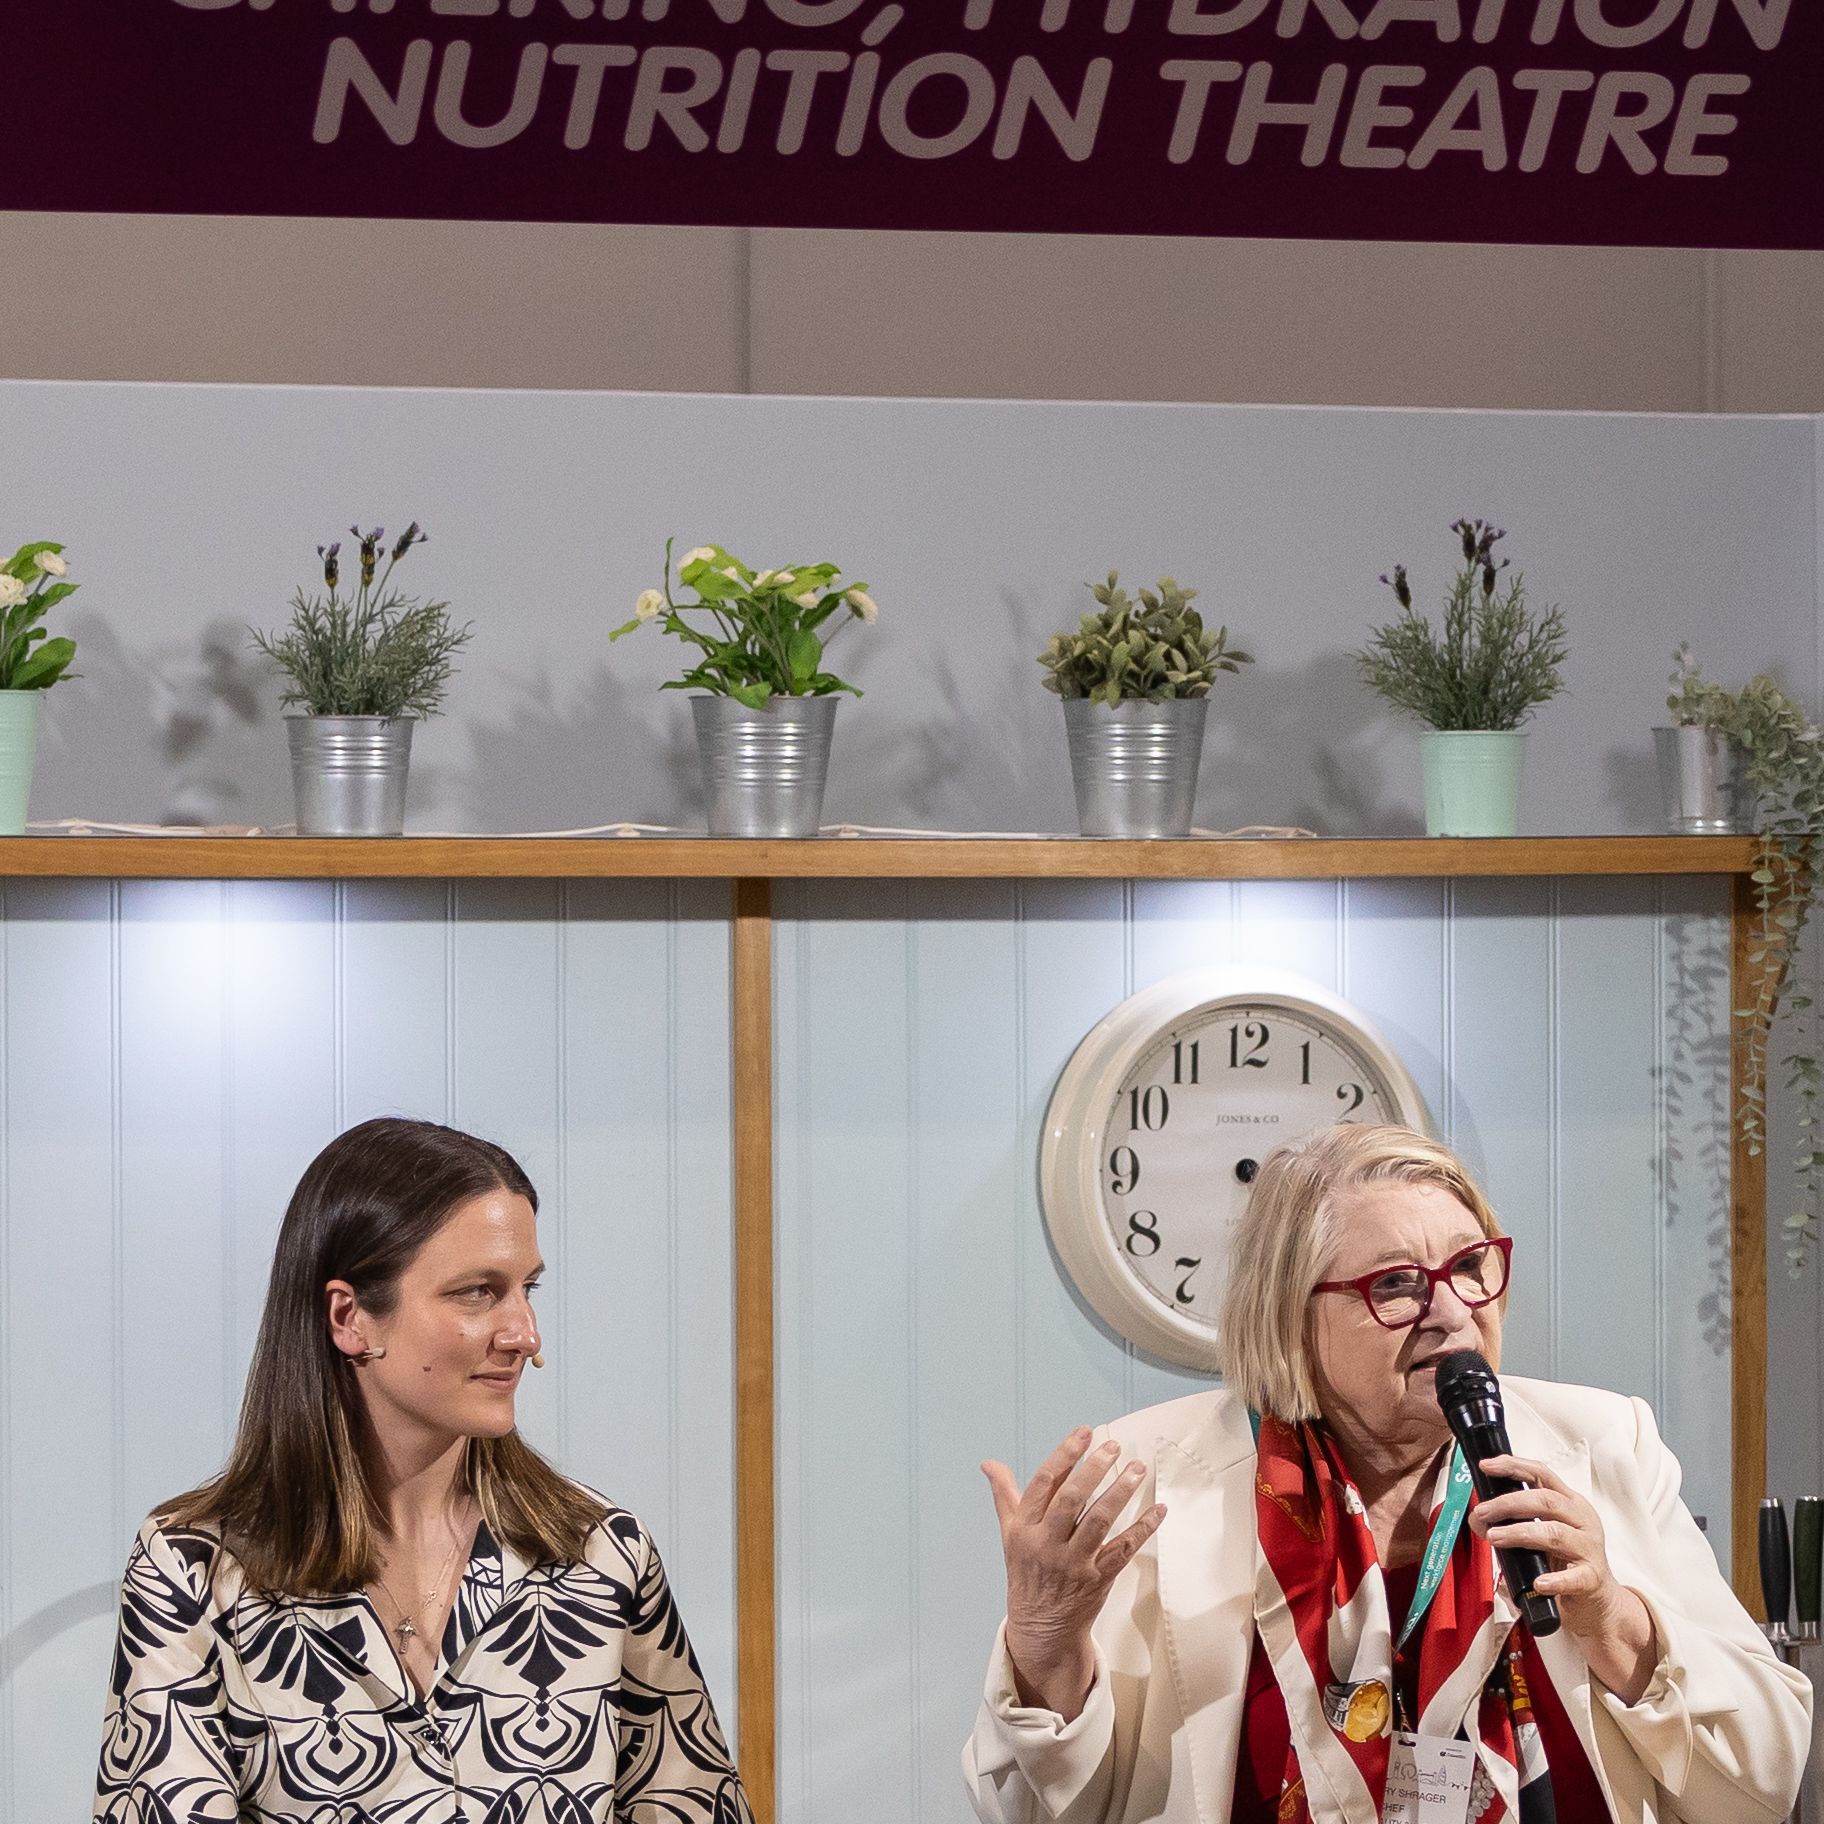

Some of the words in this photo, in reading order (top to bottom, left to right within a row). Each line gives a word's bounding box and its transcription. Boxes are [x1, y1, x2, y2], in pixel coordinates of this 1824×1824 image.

[312, 37, 1115, 162] NUTRITION
[1159, 60, 1752, 176] THEATRE
[1172, 1040, 1200, 1085] 11
[1229, 1022, 1270, 1069] 12
[1298, 1041, 1311, 1085] 1
[1129, 1085, 1169, 1131] 10
[1110, 1146, 1141, 1196] 9
[1125, 1210, 1162, 1258] 8
[1175, 1257, 1202, 1305] 7
[1420, 1571, 1430, 1590] Next
[1382, 1803, 1405, 1813] HEF
[1398, 1789, 1447, 1804] SHRAGER
